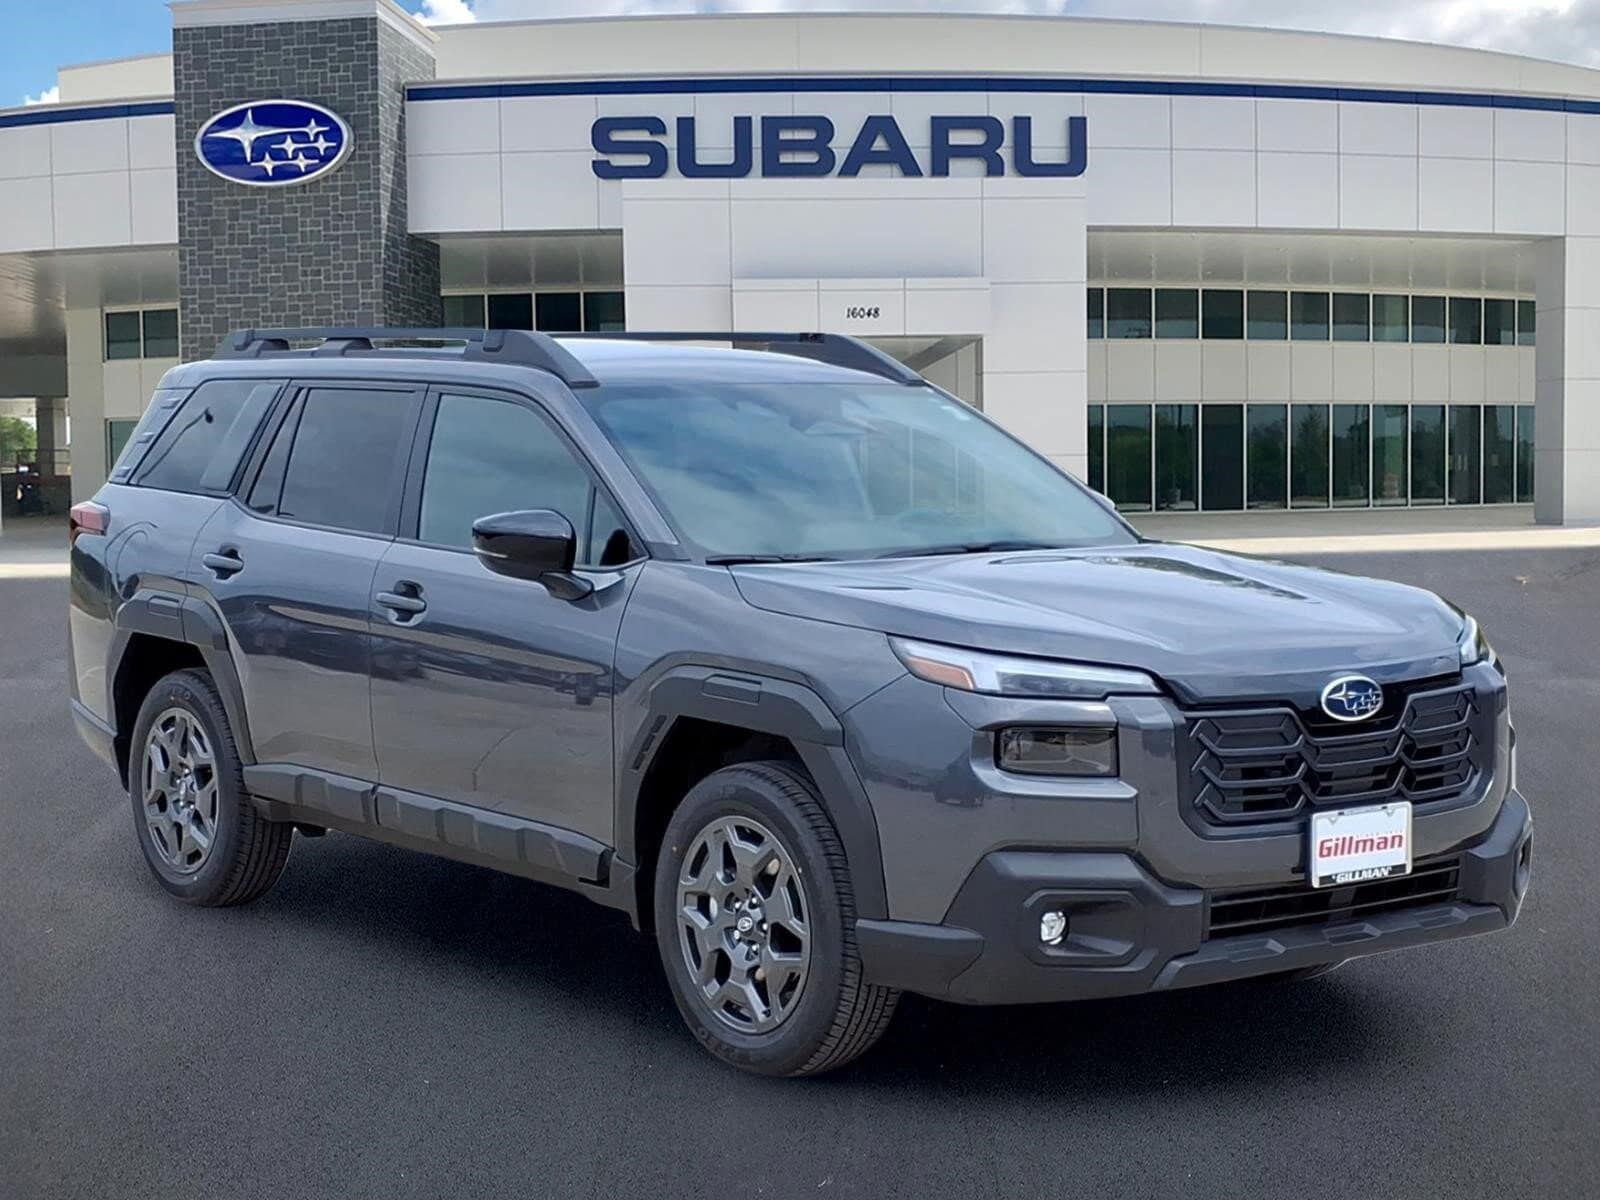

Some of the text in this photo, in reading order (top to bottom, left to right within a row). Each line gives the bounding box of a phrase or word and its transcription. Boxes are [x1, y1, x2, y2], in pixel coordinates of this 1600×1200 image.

[591, 115, 1088, 179] SUBARU
[846, 306, 880, 319] 16048
[1318, 834, 1403, 858] Gillman
